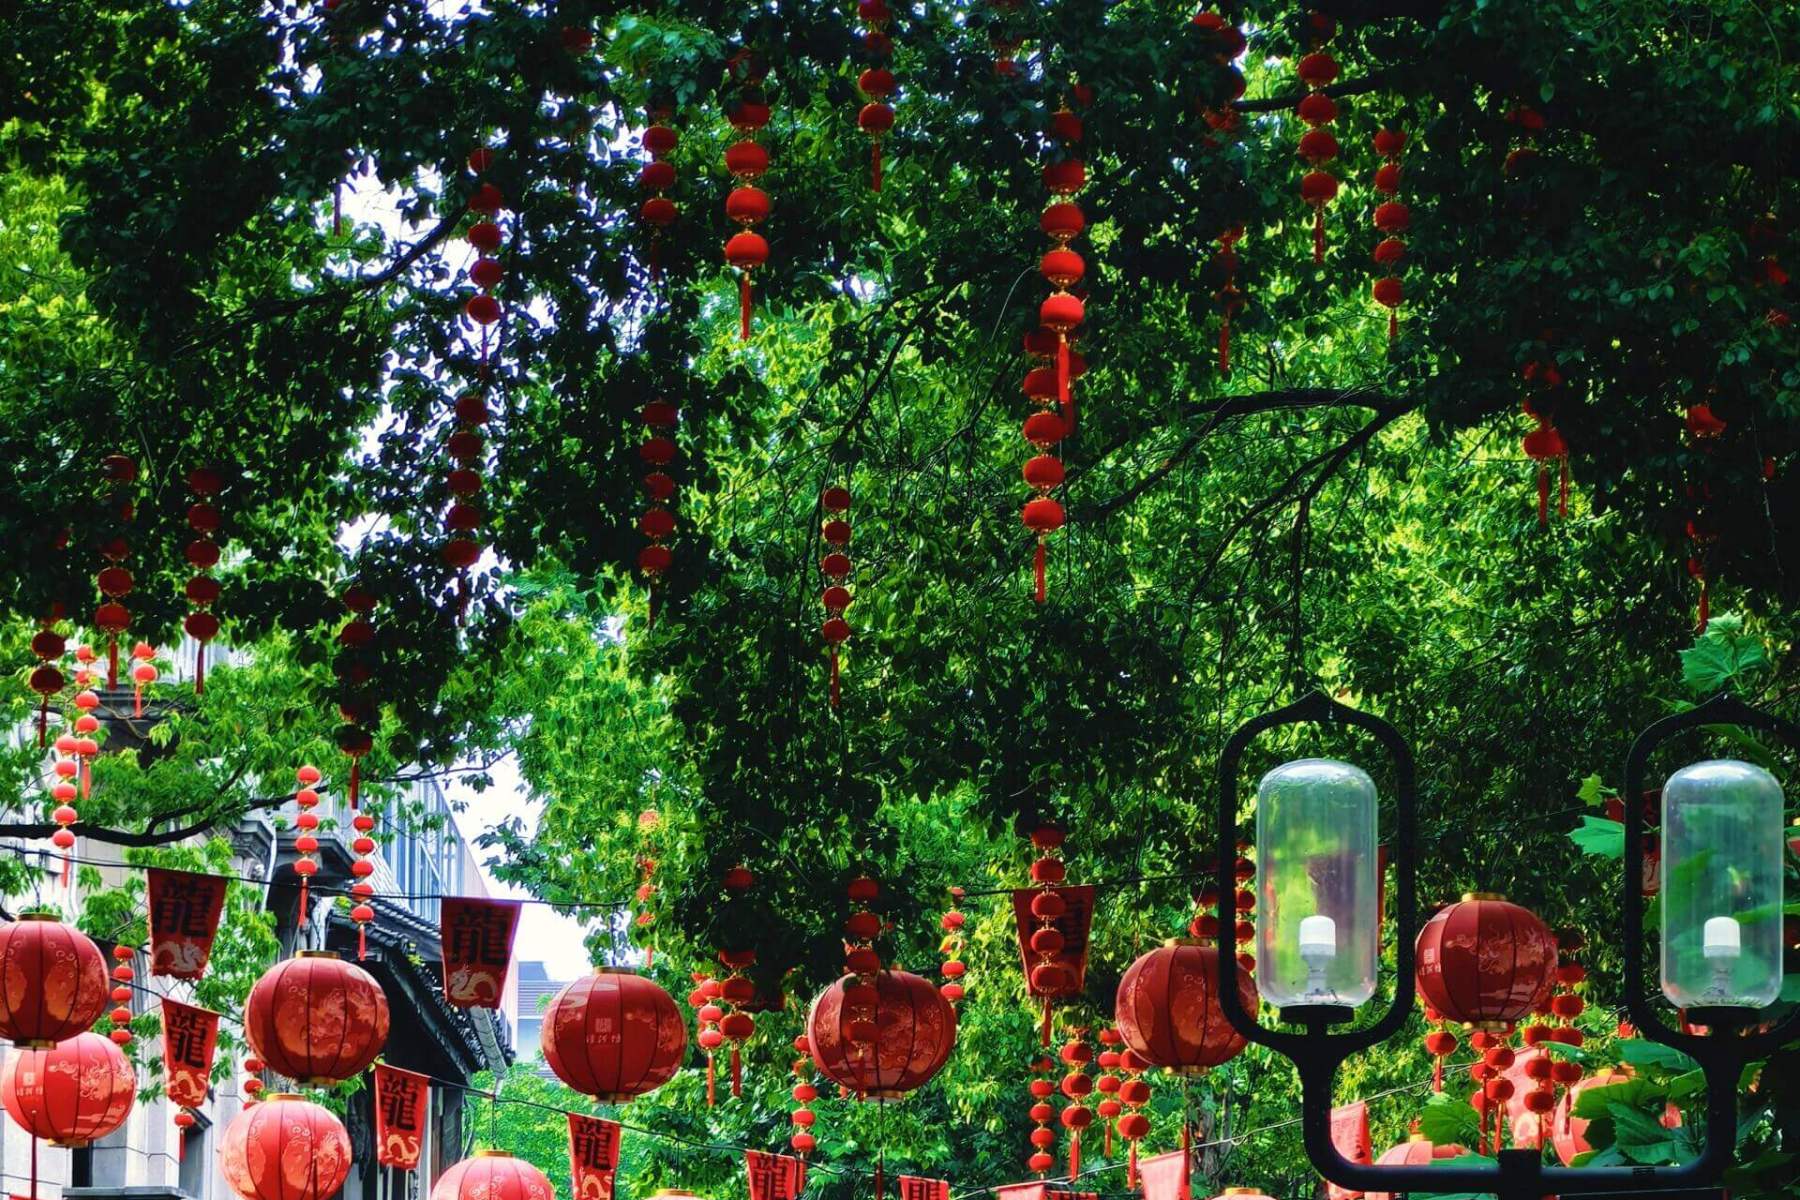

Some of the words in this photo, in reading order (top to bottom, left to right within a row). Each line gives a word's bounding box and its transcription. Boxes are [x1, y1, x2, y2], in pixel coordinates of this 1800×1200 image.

[152, 877, 216, 937] 龍
[452, 907, 509, 965] 龍
[168, 1006, 207, 1069] 龍
[379, 1073, 418, 1131] 龍
[573, 1115, 612, 1171] 龍
